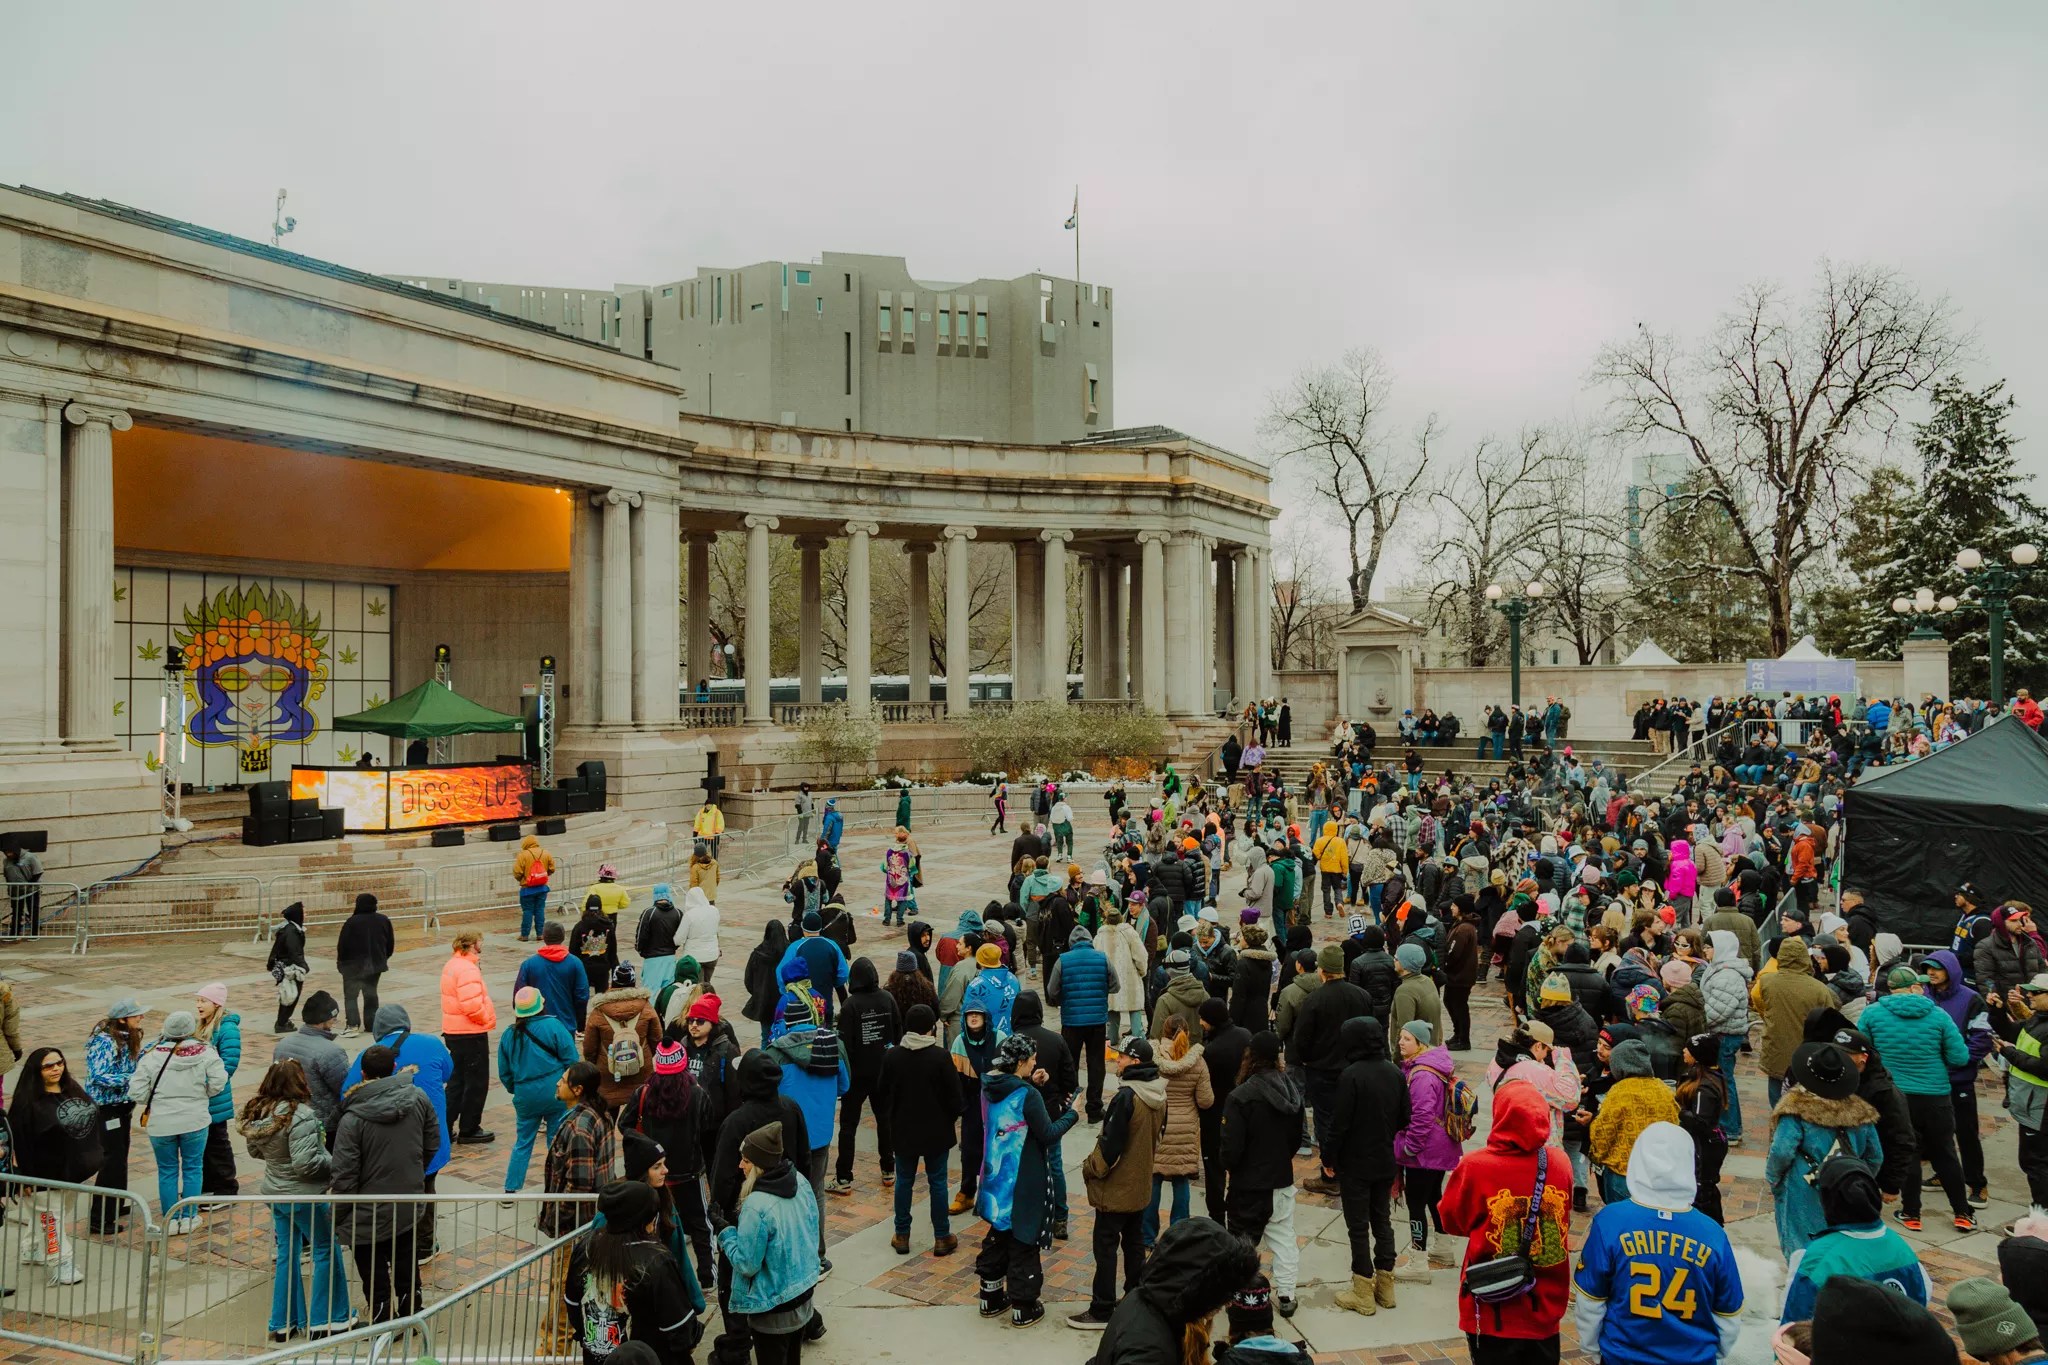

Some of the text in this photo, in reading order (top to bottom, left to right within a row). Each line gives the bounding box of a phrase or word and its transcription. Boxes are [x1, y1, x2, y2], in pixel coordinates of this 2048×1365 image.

[1751, 662, 1765, 690] BAR
[1531, 1182, 1545, 1212] GRIZ
[1620, 1230, 1713, 1268] GRIFFEY
[1629, 1261, 1698, 1320] 24
